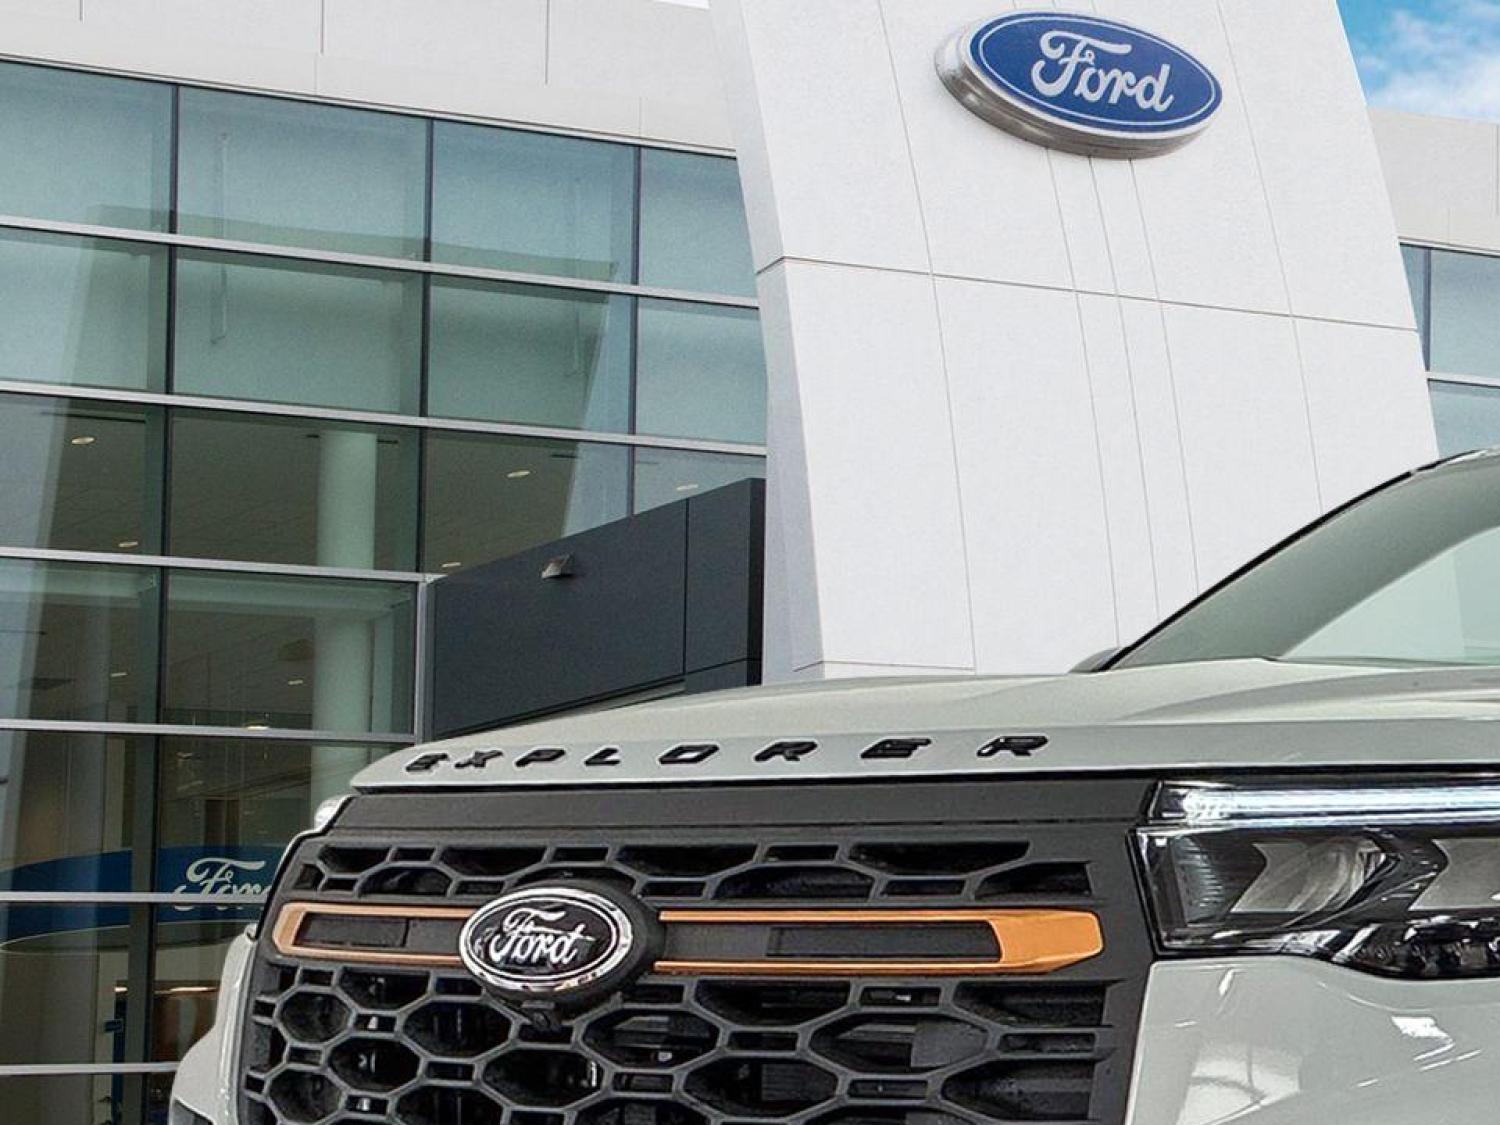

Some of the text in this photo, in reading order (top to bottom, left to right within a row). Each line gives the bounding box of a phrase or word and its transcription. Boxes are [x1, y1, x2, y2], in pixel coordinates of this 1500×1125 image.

[1032, 31, 1174, 112] Ford
[406, 735, 1048, 772] EXPLORER
[489, 907, 595, 965] Ford
